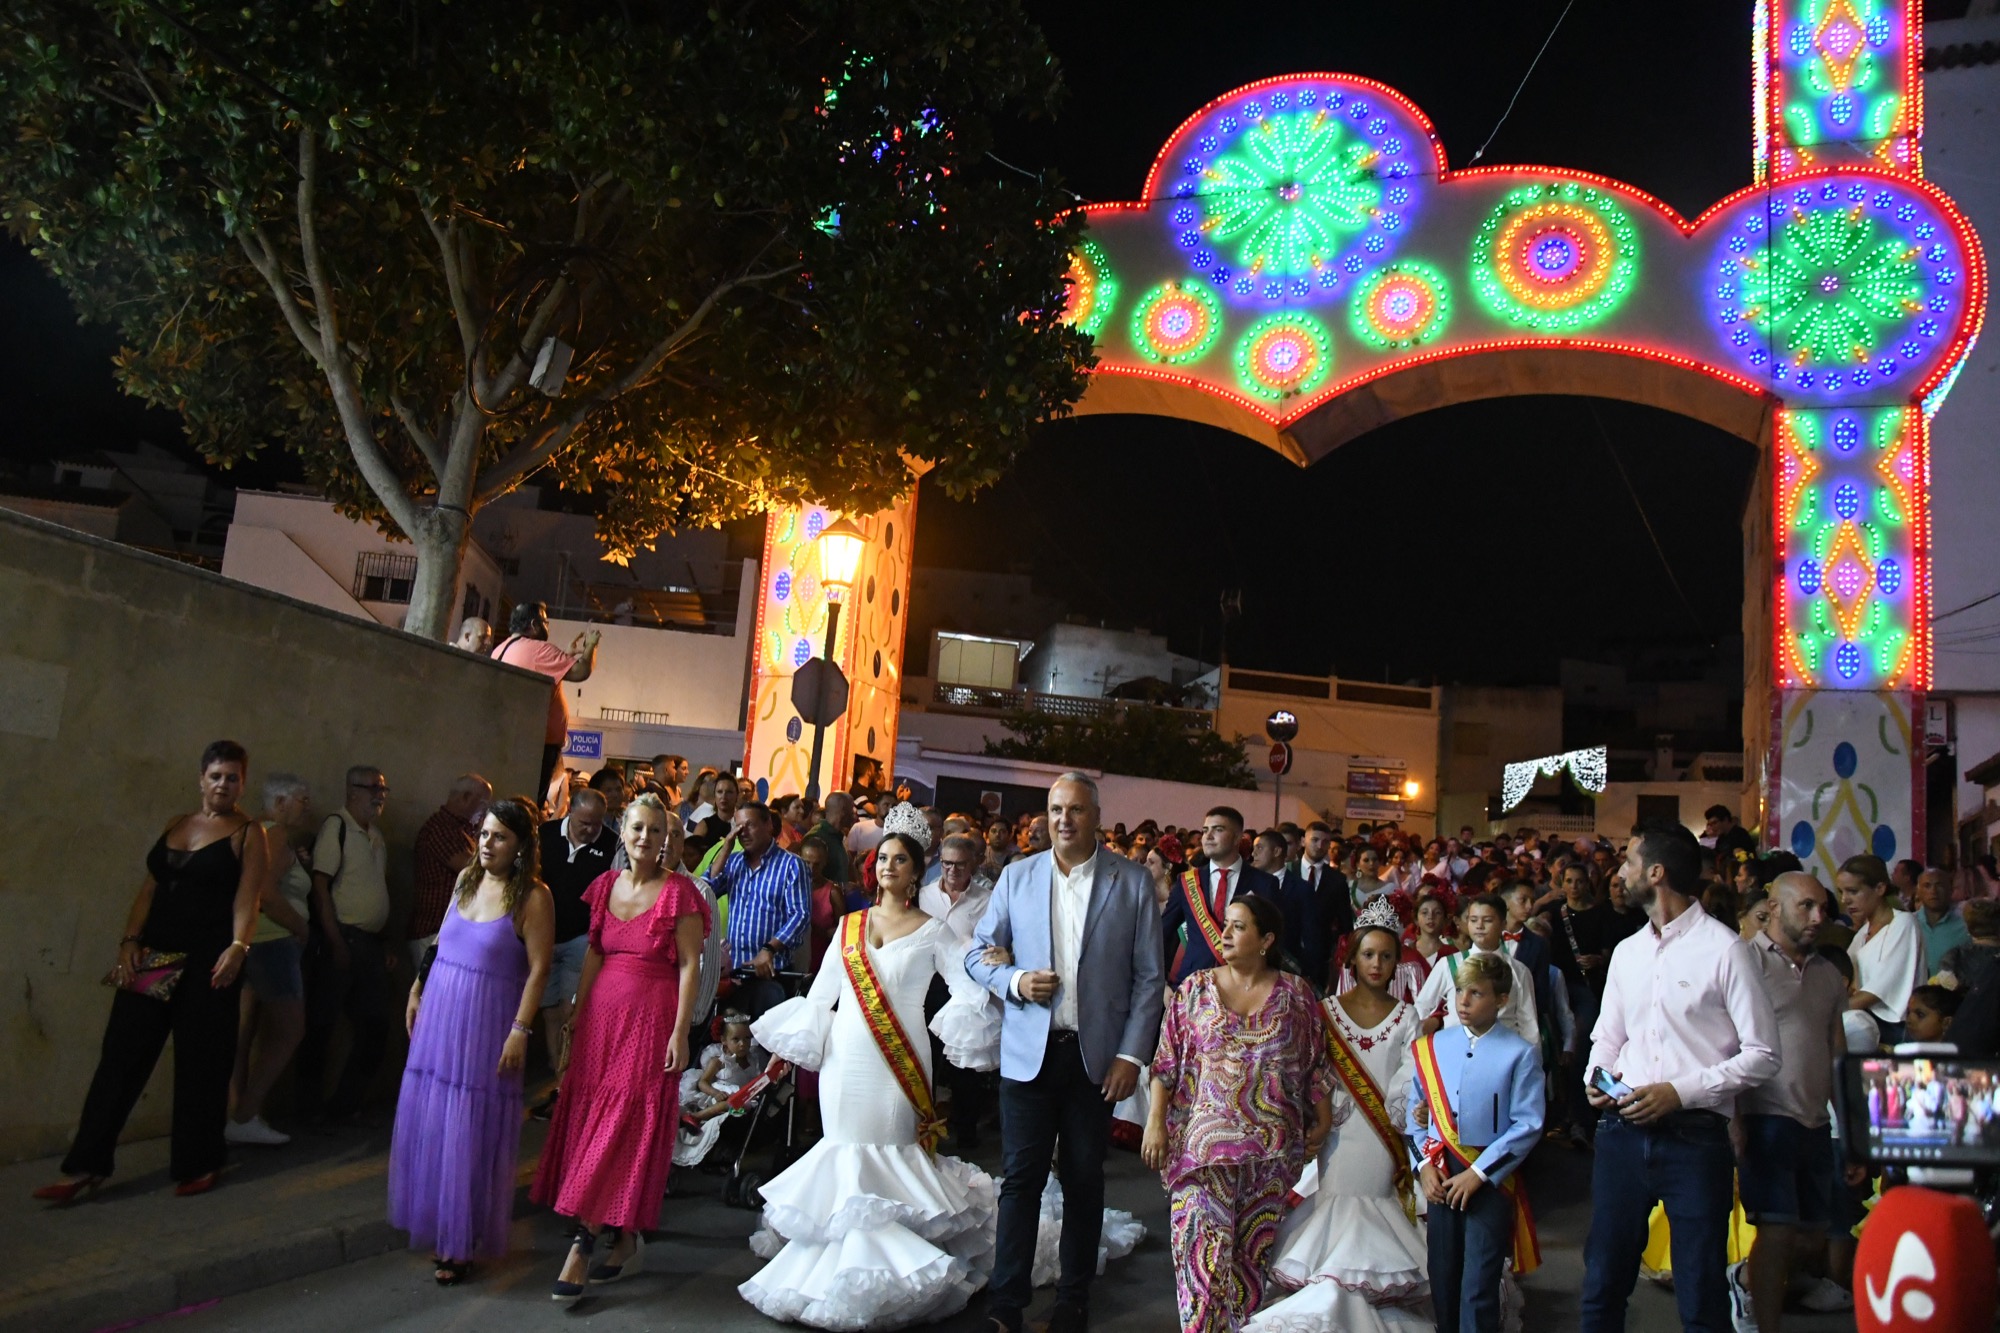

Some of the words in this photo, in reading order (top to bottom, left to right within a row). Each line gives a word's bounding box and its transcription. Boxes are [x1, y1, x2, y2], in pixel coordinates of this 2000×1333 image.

[573, 735, 599, 745] POLICÍA
[572, 745, 595, 754] LOCAL
[1270, 753, 1285, 764] STOP
[589, 848, 604, 857] FILA
[848, 956, 866, 985] Reina
[871, 1003, 889, 1027] Real
[891, 1043, 909, 1072] Roque
